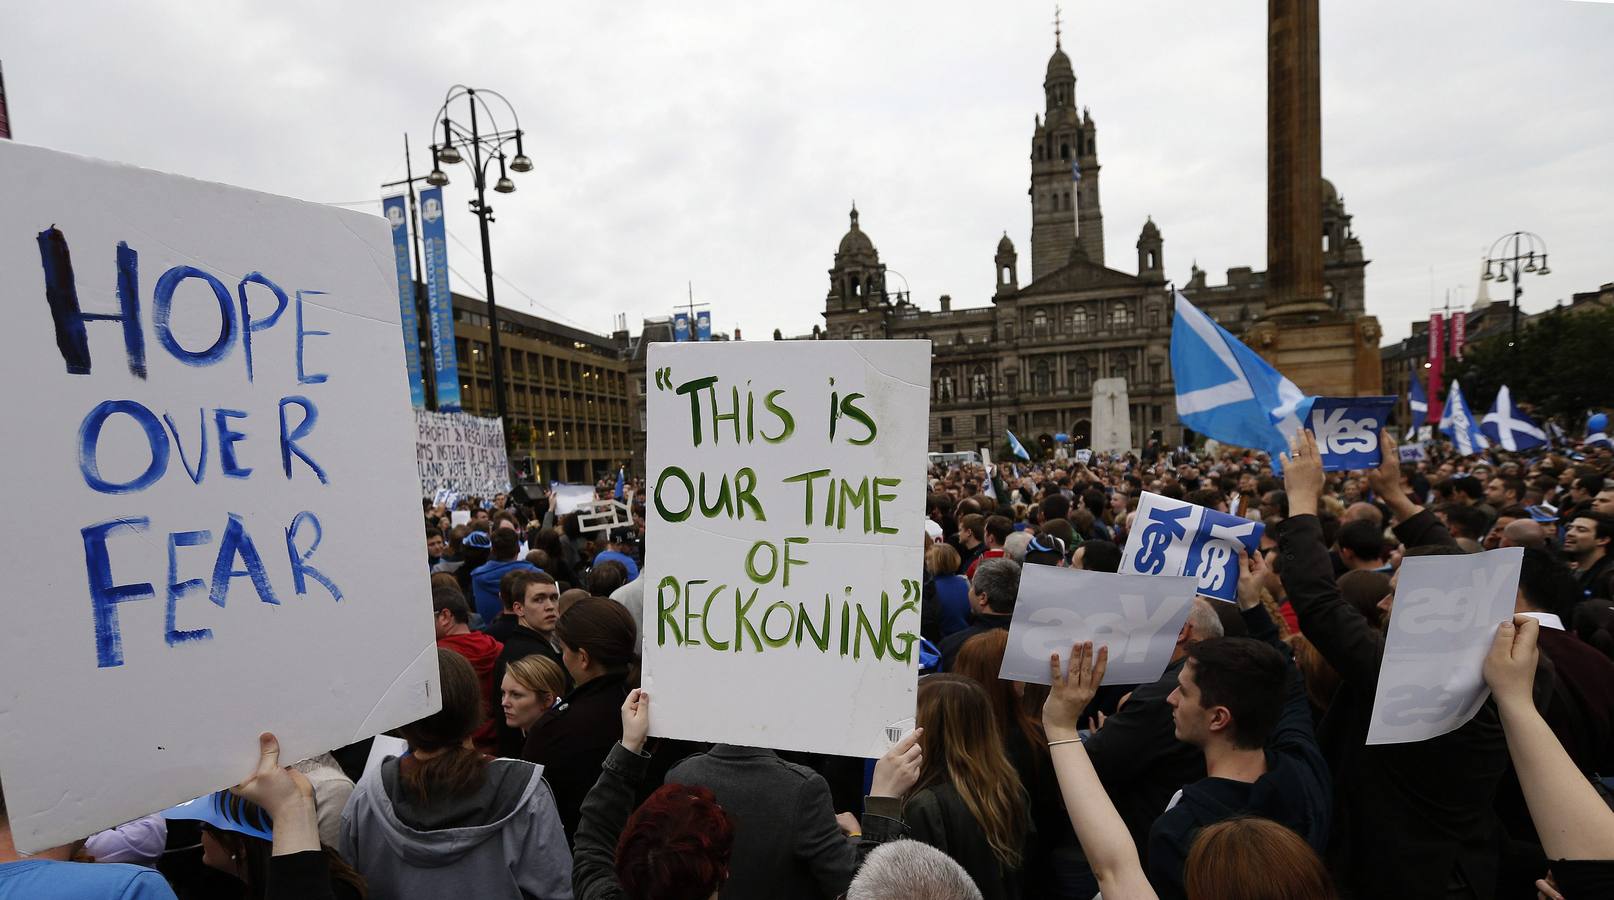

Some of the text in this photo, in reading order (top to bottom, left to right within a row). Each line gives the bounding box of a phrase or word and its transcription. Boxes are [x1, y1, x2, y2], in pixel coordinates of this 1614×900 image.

[434, 238, 444, 265] CUP
[36, 224, 330, 384] HOPE
[425, 237, 443, 372] GLASGOW WELCOMES
[437, 268, 449, 310] RYDER
[443, 343, 453, 369] THE
[77, 395, 330, 495] OVER
[418, 424, 450, 442] PROFIT
[436, 444, 465, 461] INSTEAD
[1312, 407, 1379, 455] Yes
[421, 478, 437, 495] FOR
[447, 461, 466, 477] VOTE
[654, 465, 902, 535] OUR TIME
[744, 536, 811, 589] OF
[1134, 505, 1193, 575] Yes
[1196, 521, 1256, 591] Yes
[80, 510, 346, 668] FEAR
